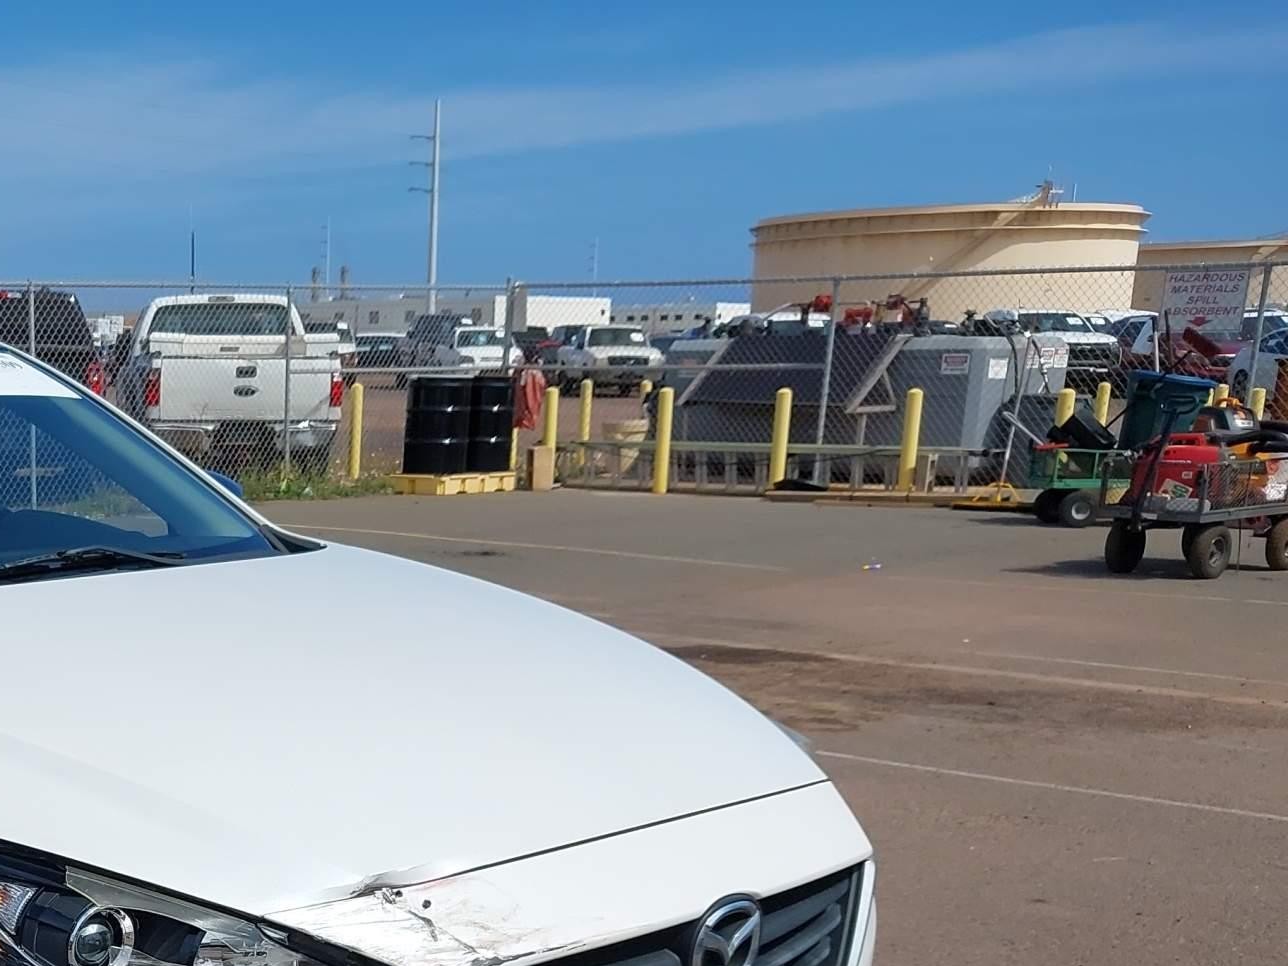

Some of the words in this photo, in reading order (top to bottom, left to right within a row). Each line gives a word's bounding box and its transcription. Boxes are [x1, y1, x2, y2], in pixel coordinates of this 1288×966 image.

[1169, 272, 1246, 283] HAZARDOUS
[1170, 284, 1241, 294] MATERIALS
[1186, 295, 1220, 305] SPILL
[1166, 306, 1240, 316] ABSORBENT
